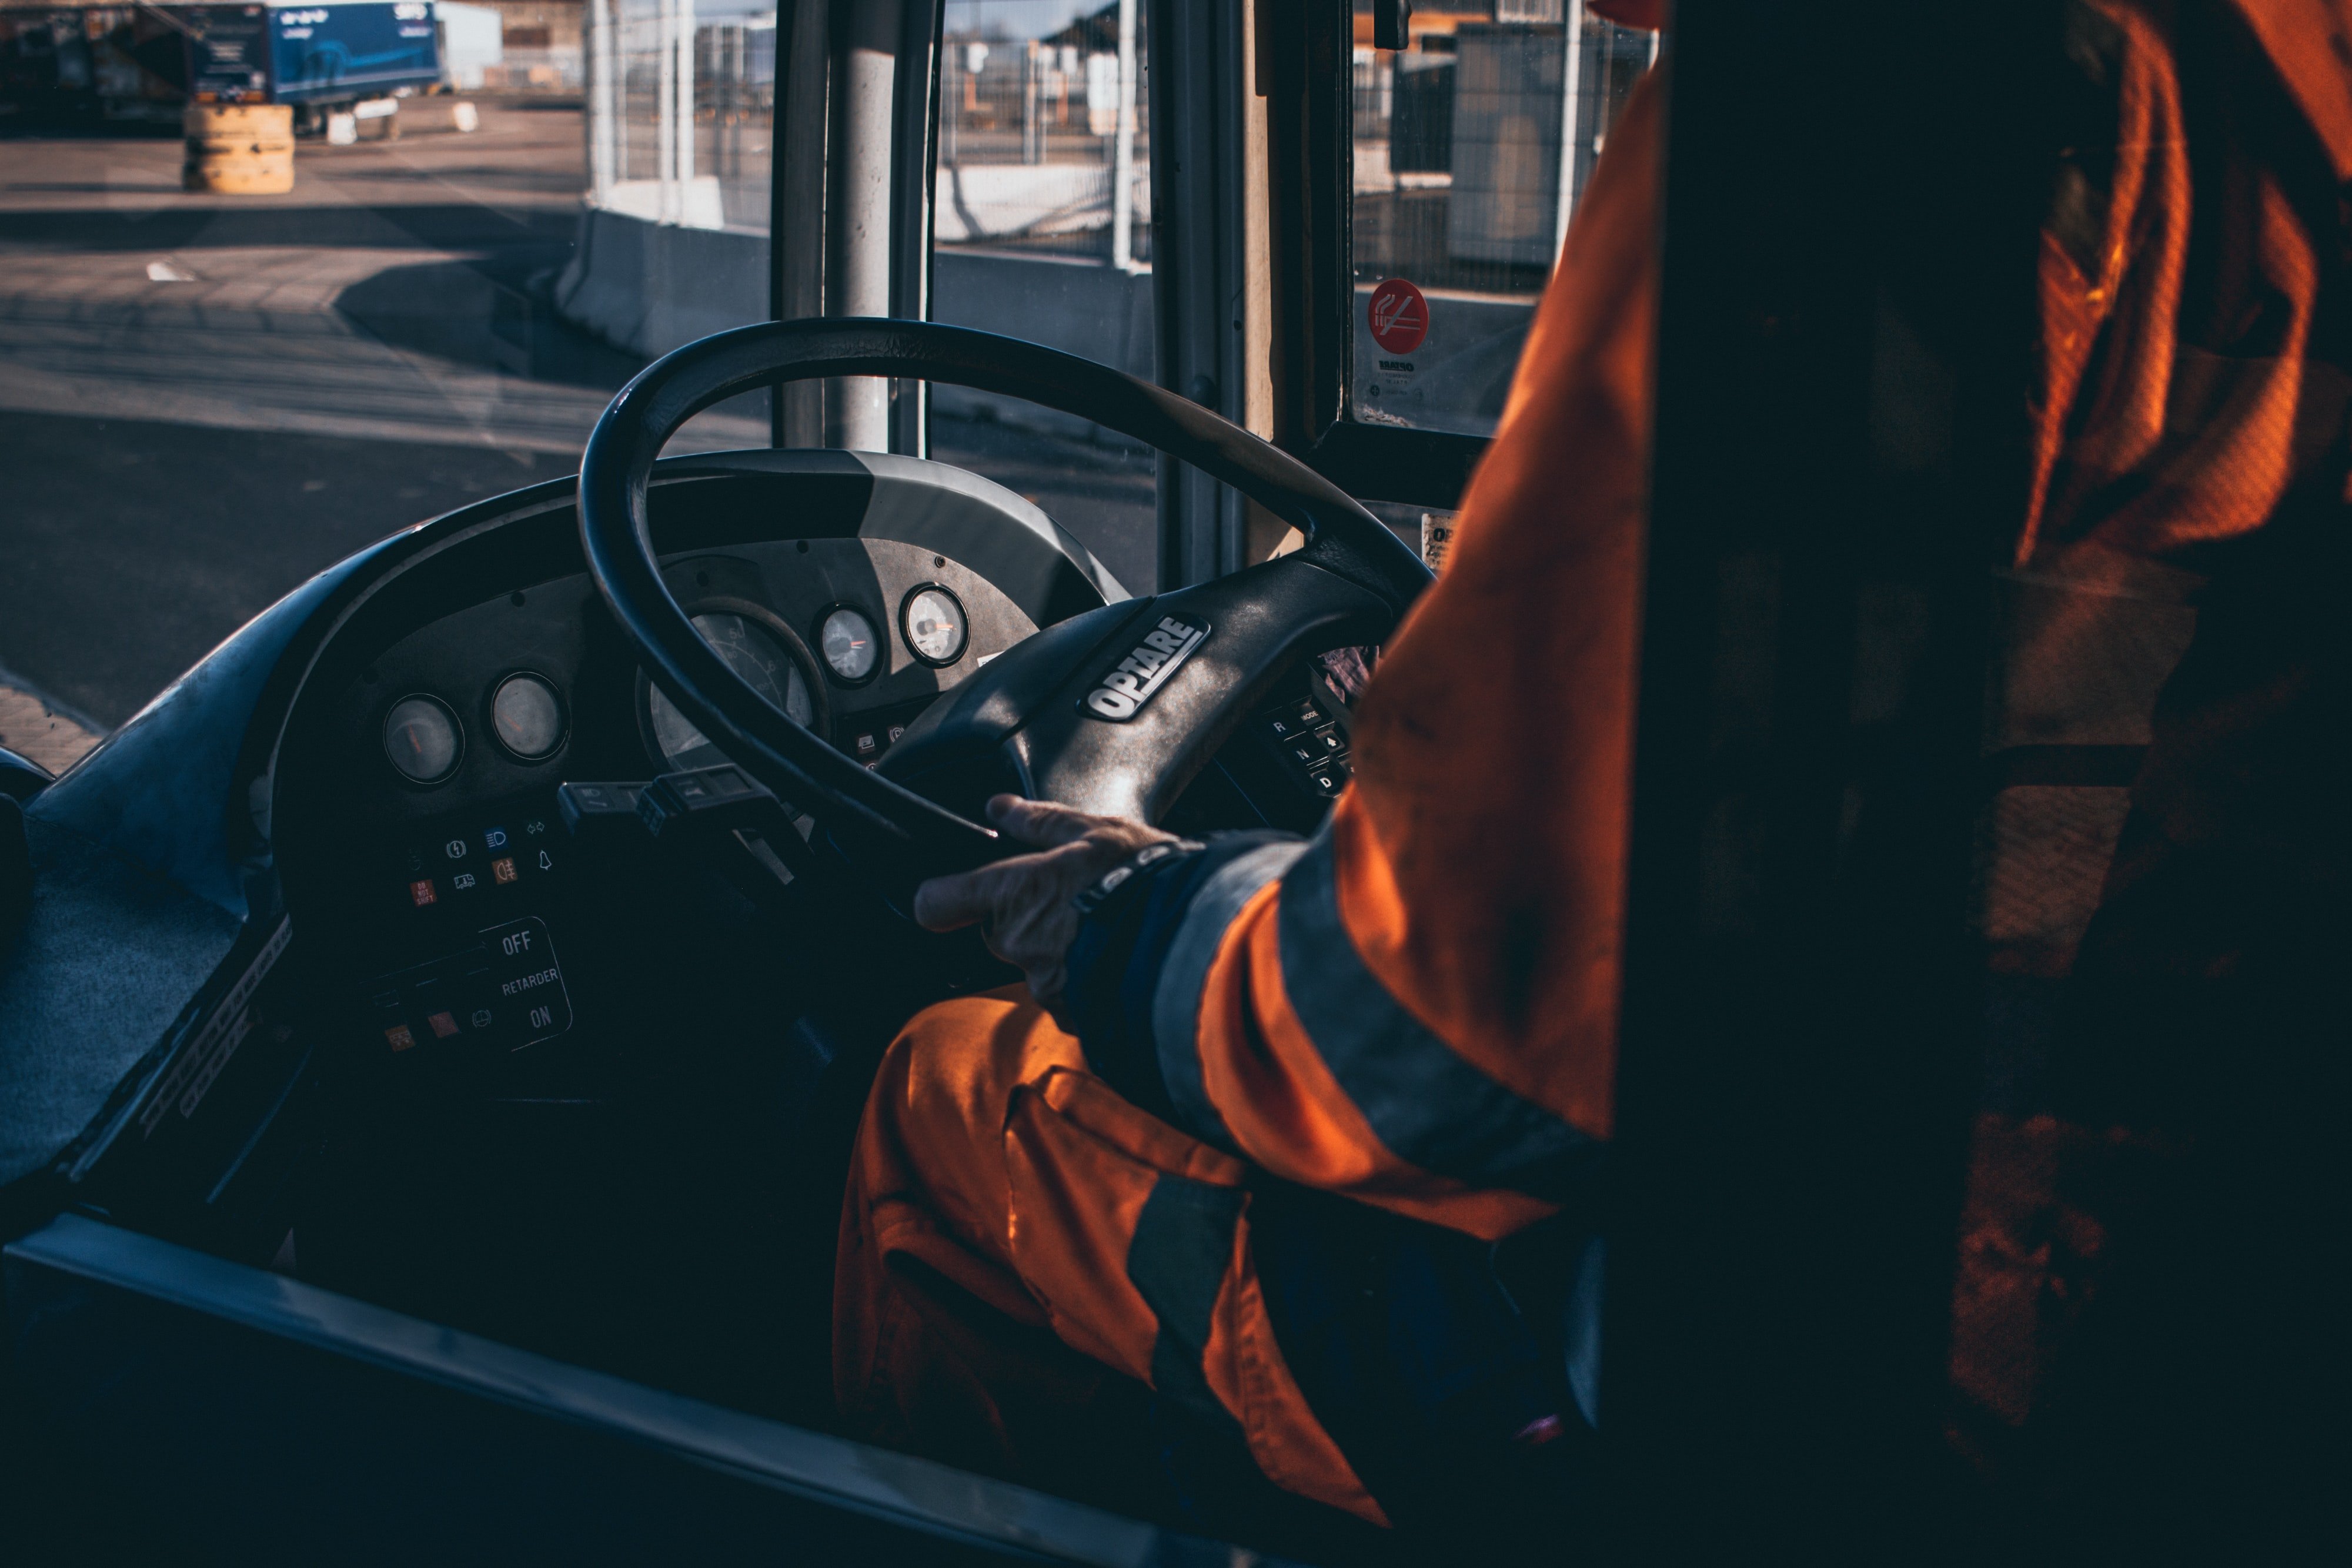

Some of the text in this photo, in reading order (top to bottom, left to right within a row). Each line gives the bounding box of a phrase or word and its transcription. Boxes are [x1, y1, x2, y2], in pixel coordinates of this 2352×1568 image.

[1087, 616, 1195, 718] OPTARE
[1301, 710, 1319, 721] MODE
[1273, 722, 1286, 733] R
[1296, 749, 1309, 760] N
[1319, 777, 1332, 788] D
[417, 889, 429, 897] NOT
[417, 895, 433, 905] SHIFT
[502, 930, 531, 955] OFF
[502, 968, 558, 996] RETARDER
[530, 1005, 552, 1029] ON
